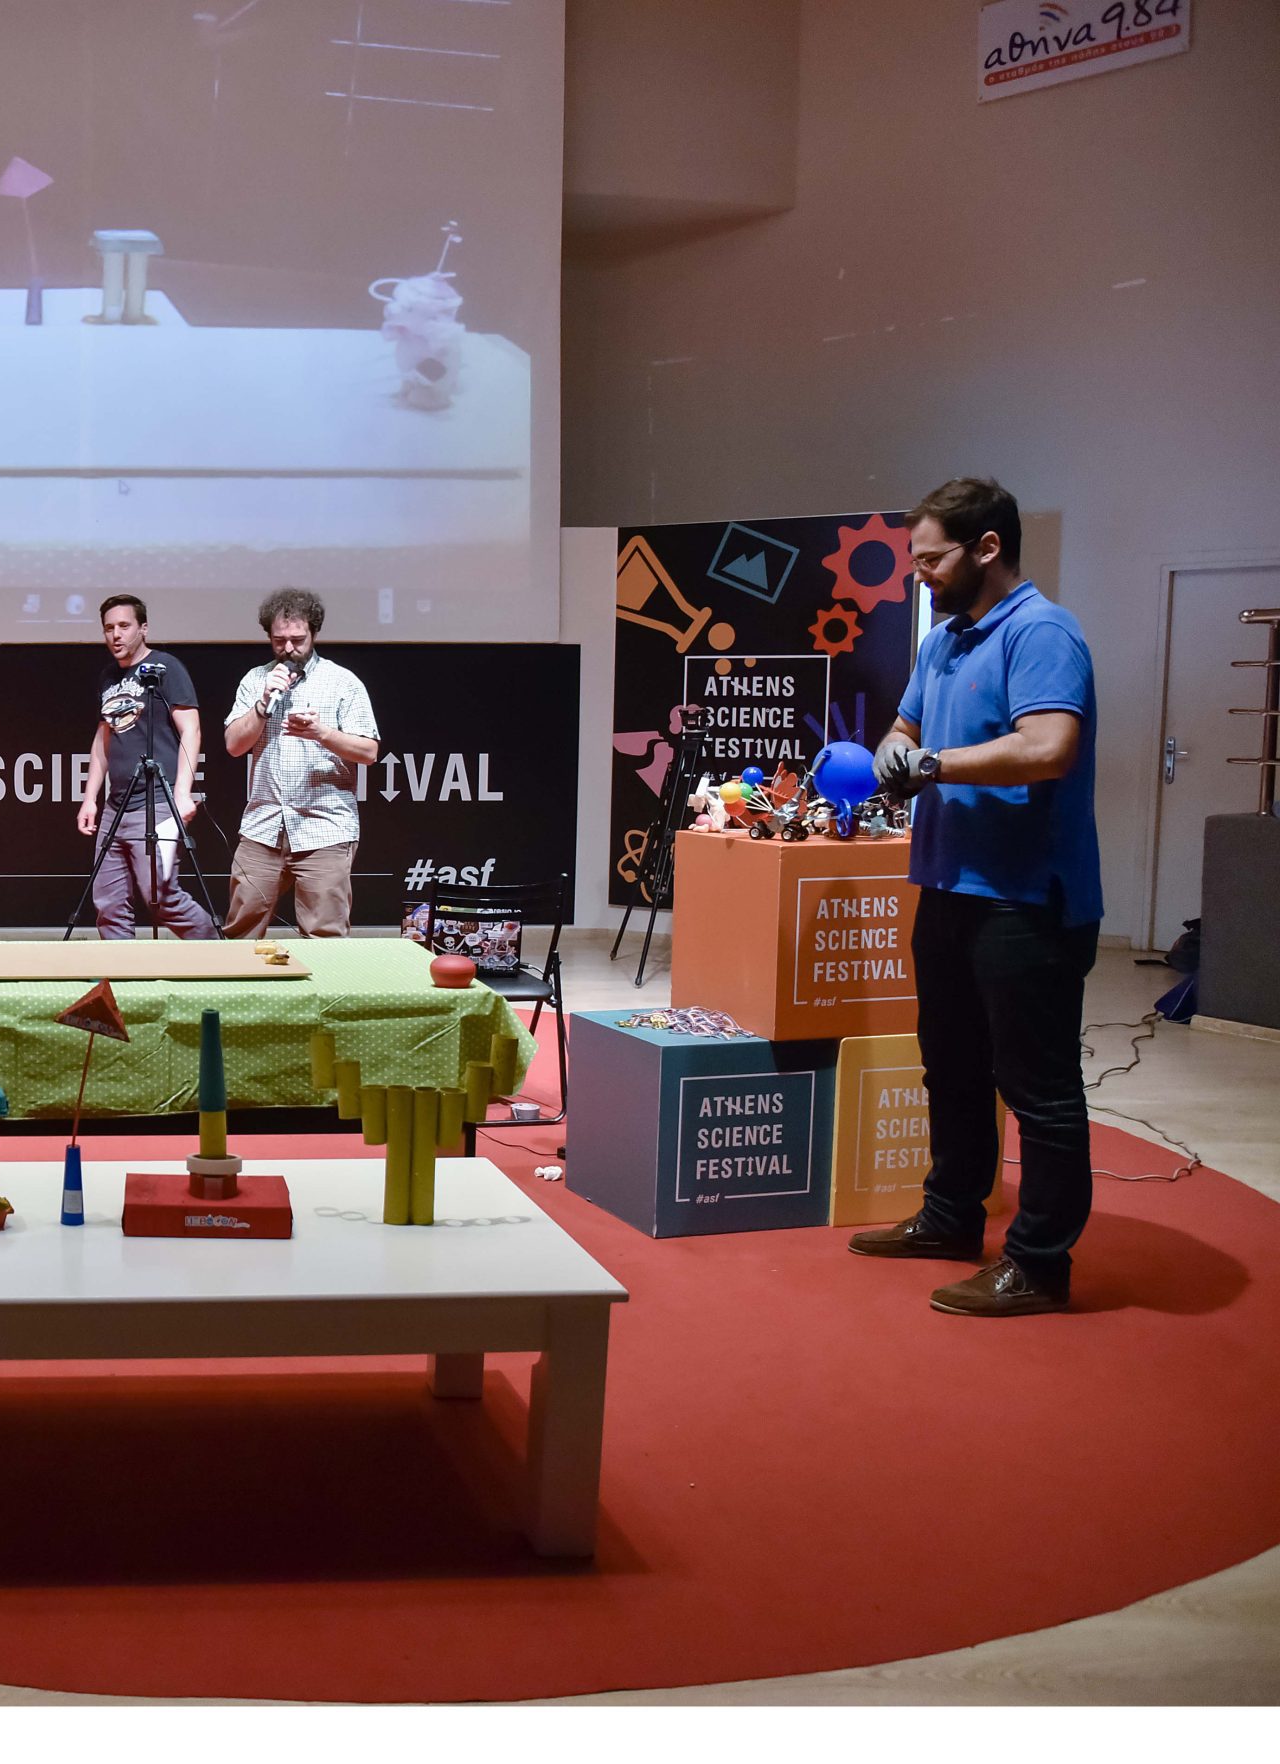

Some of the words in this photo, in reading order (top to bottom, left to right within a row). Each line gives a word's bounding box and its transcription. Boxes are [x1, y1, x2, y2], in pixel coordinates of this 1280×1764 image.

[704, 675, 795, 697] ATHENS
[705, 706, 795, 728] SCIENCE
[404, 858, 496, 891] #asf
[816, 896, 899, 920] ATHENS
[815, 927, 898, 951] SCIENCE
[813, 959, 907, 983] FESTIVAL
[813, 996, 837, 1007] #asf
[698, 1092, 784, 1118] ATHENS
[878, 1086, 929, 1109] ATHE
[697, 1124, 783, 1150] SCIENCE
[876, 1117, 930, 1140] SCIEN
[695, 1154, 793, 1180] FESTIVAL
[874, 1147, 930, 1170] FESTI
[695, 1193, 721, 1205] #asf
